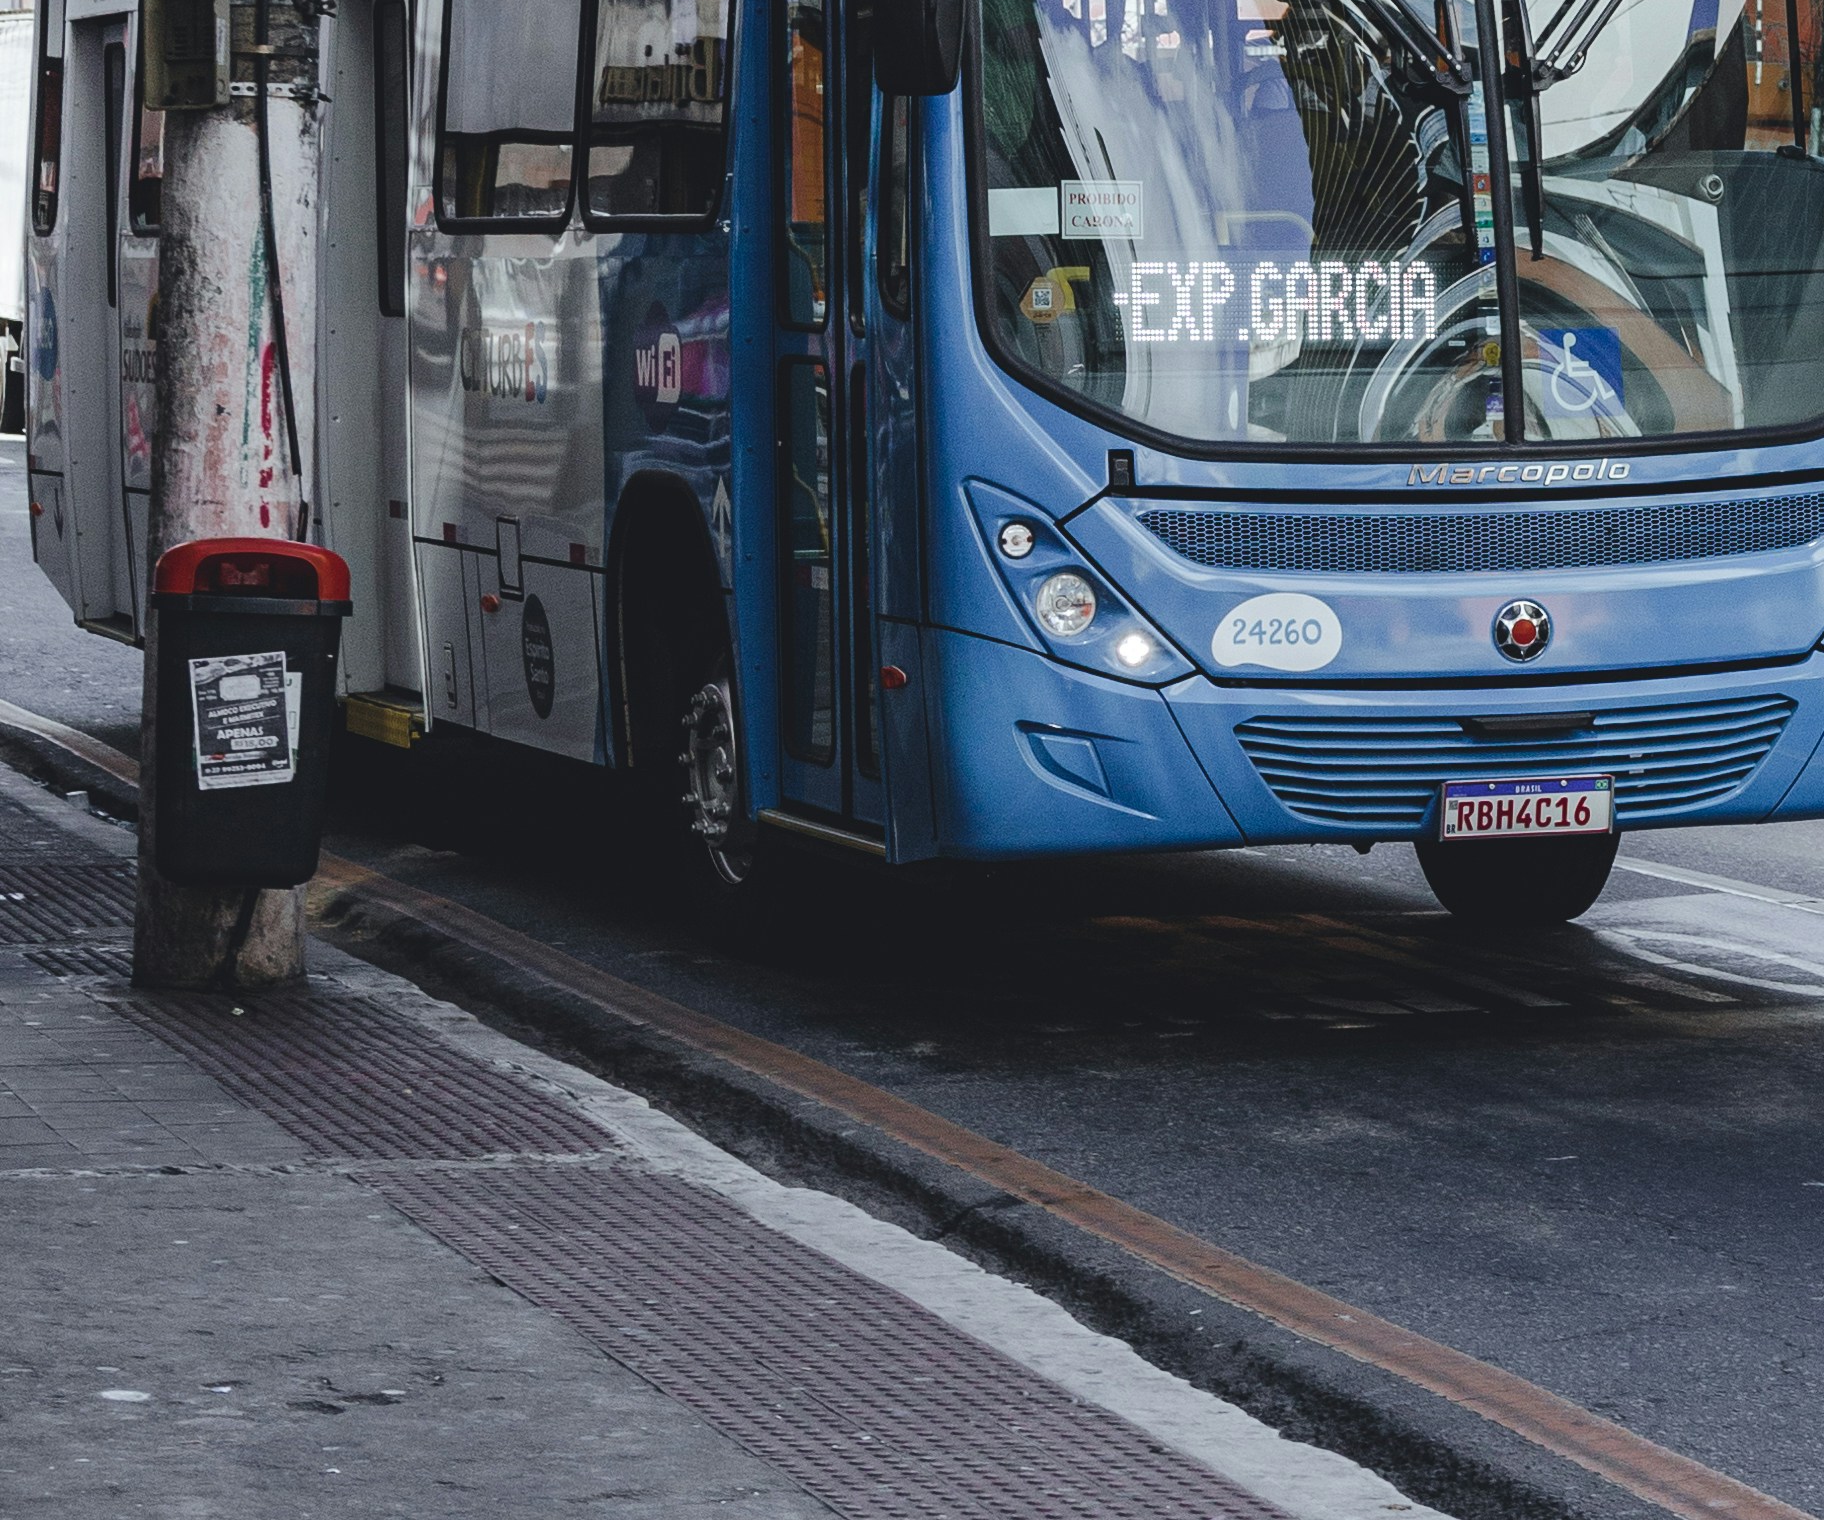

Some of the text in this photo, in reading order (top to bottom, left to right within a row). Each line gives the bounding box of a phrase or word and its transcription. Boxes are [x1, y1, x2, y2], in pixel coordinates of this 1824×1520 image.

[1069, 193, 1137, 205] PROIBIDO
[1071, 214, 1134, 228] CARONA
[1407, 458, 1631, 486] Marcopolo
[1233, 618, 1322, 646] 24260
[217, 726, 264, 739] APENAS
[1515, 785, 1542, 794] BRASIL
[1457, 796, 1591, 831] RBH4C16
[1446, 823, 1456, 834] BR
